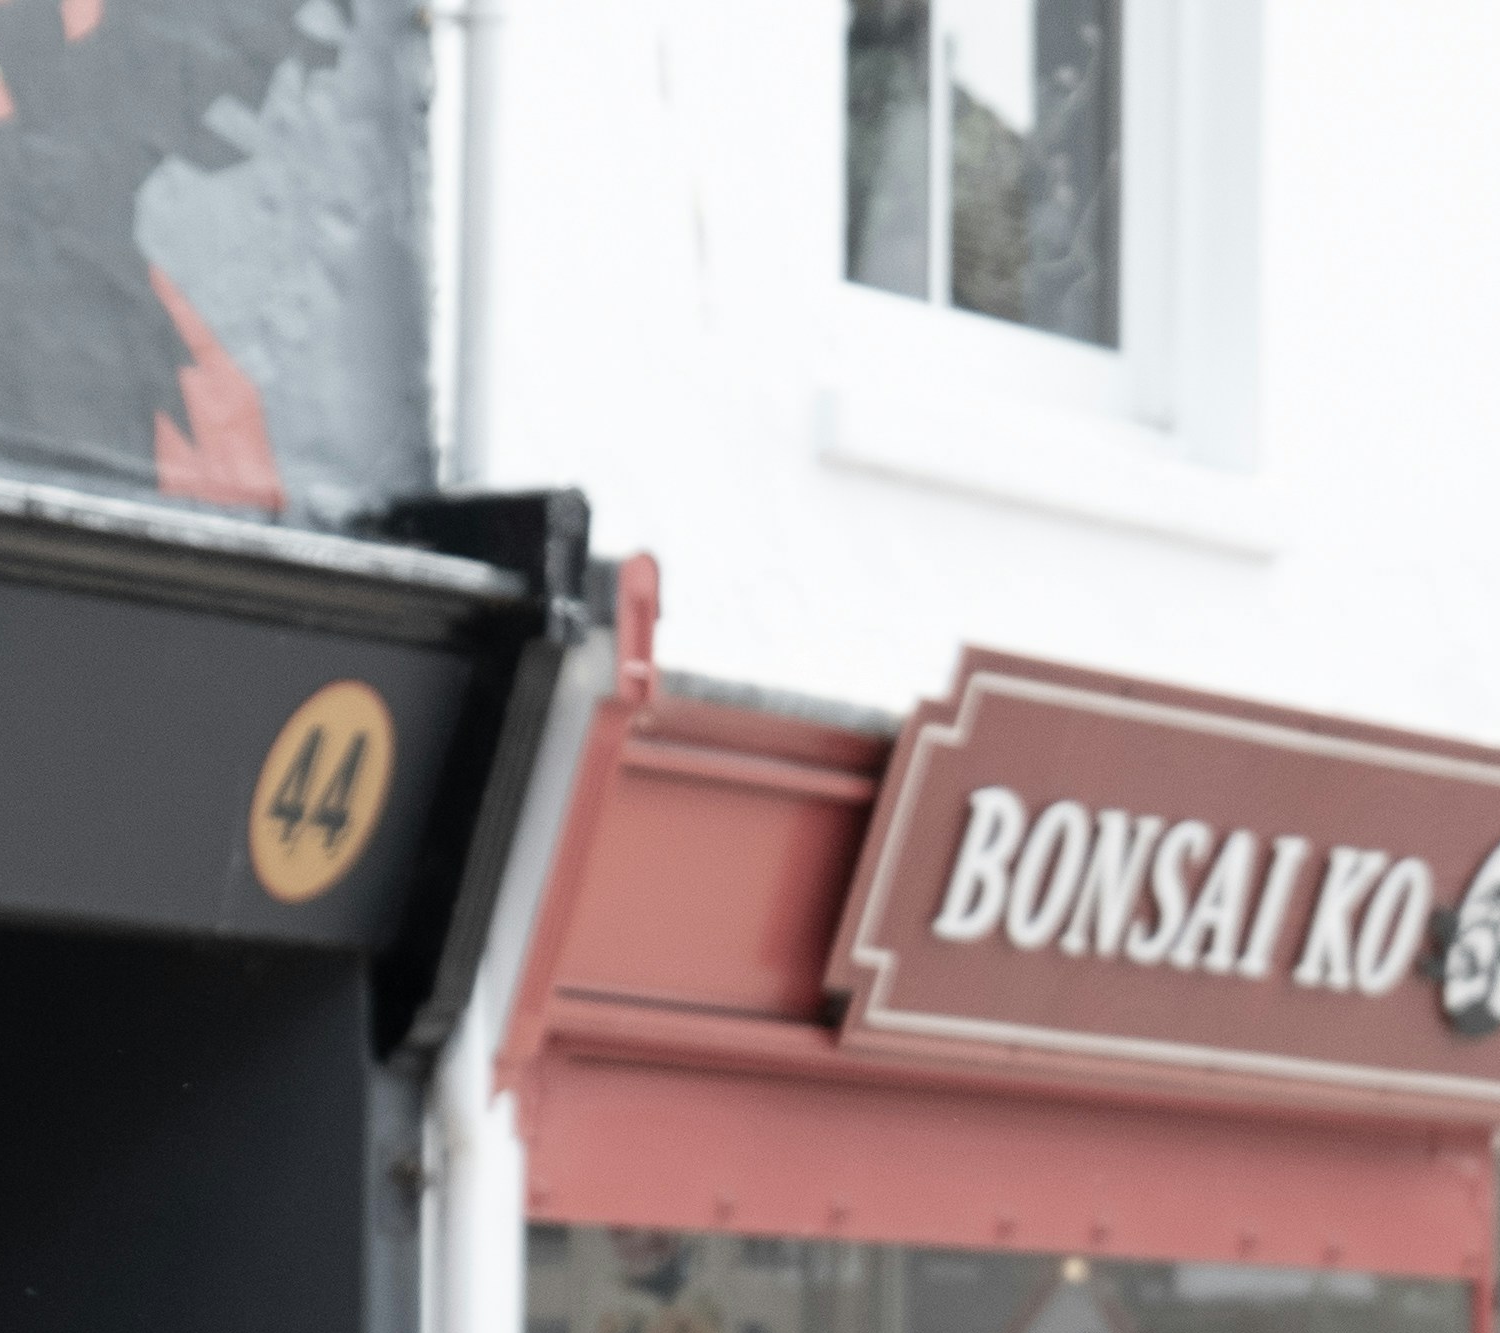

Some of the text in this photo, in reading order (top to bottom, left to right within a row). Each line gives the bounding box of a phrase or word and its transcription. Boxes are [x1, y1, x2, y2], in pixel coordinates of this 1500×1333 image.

[267, 724, 369, 857] 44
[931, 786, 1434, 995] BONSAI KO
